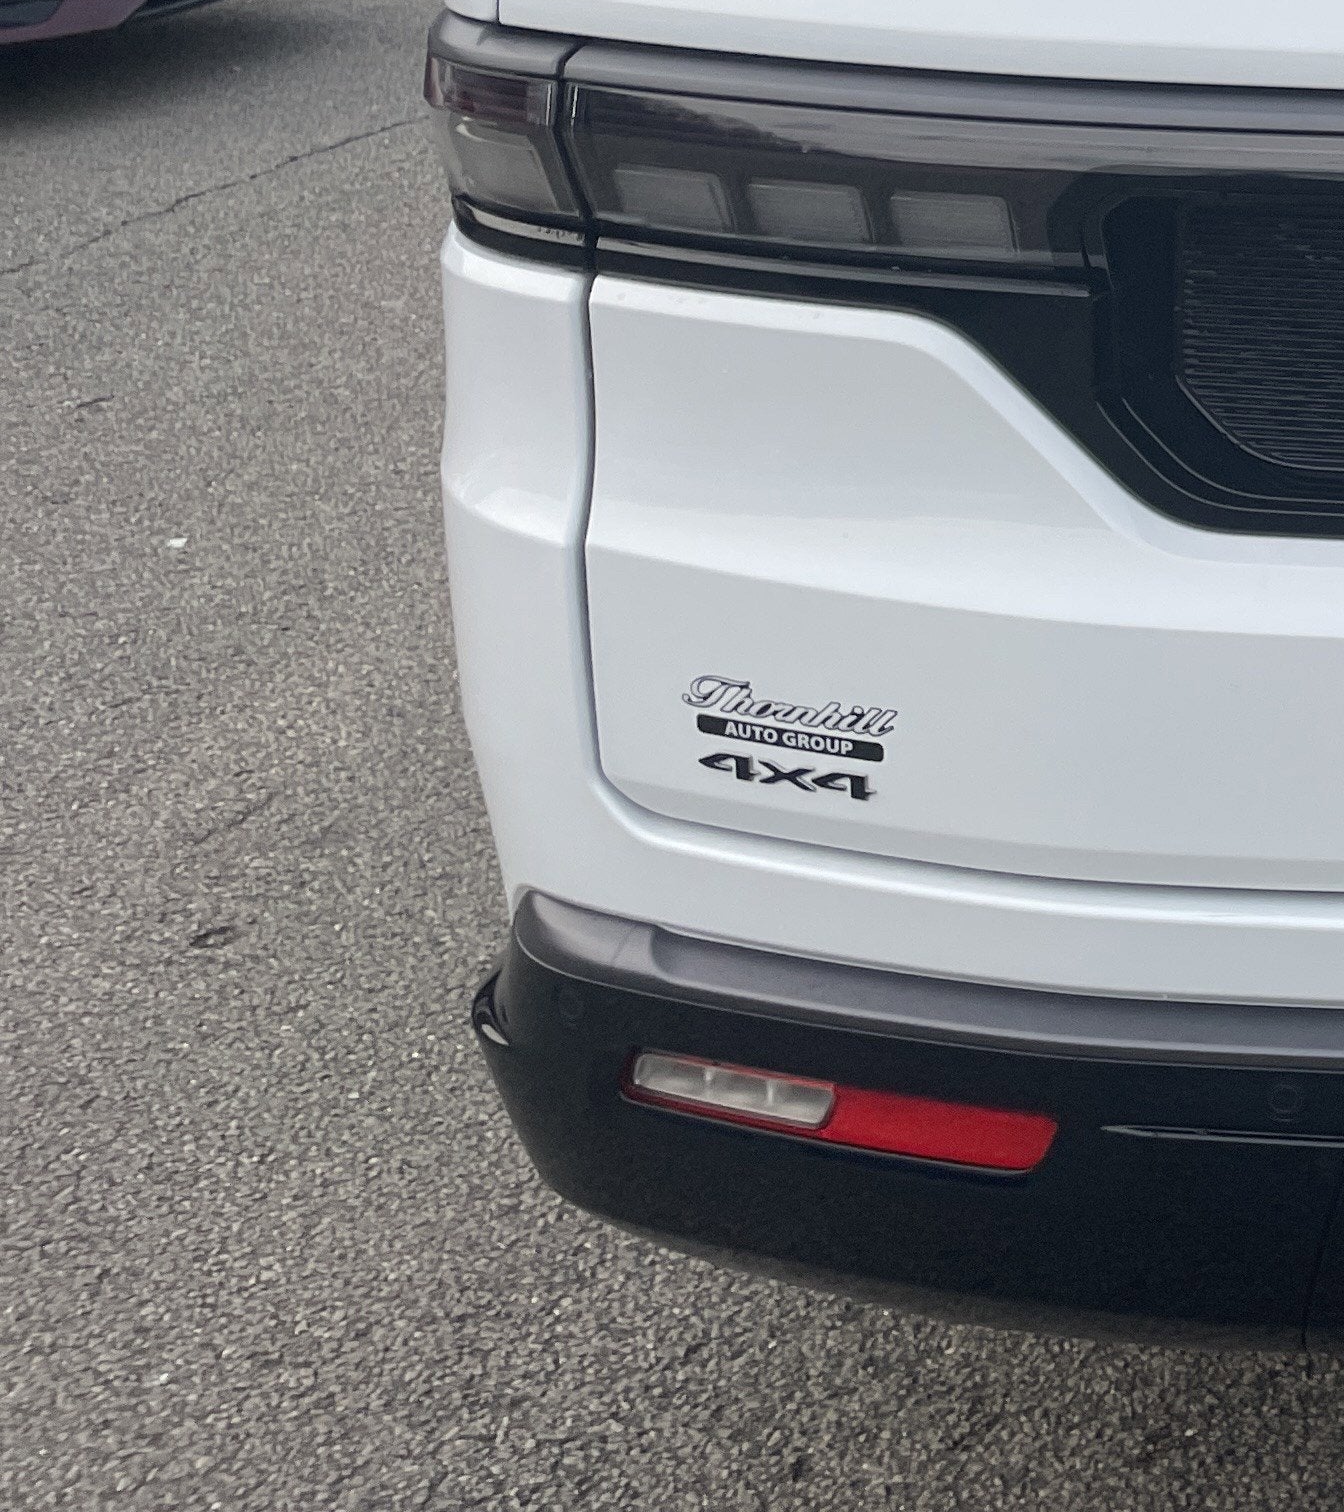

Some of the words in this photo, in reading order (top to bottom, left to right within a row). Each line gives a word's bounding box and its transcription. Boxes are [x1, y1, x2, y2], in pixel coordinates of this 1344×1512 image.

[682, 674, 898, 737] Thornhill
[724, 720, 779, 744] AUTO
[782, 731, 854, 756] GROUP
